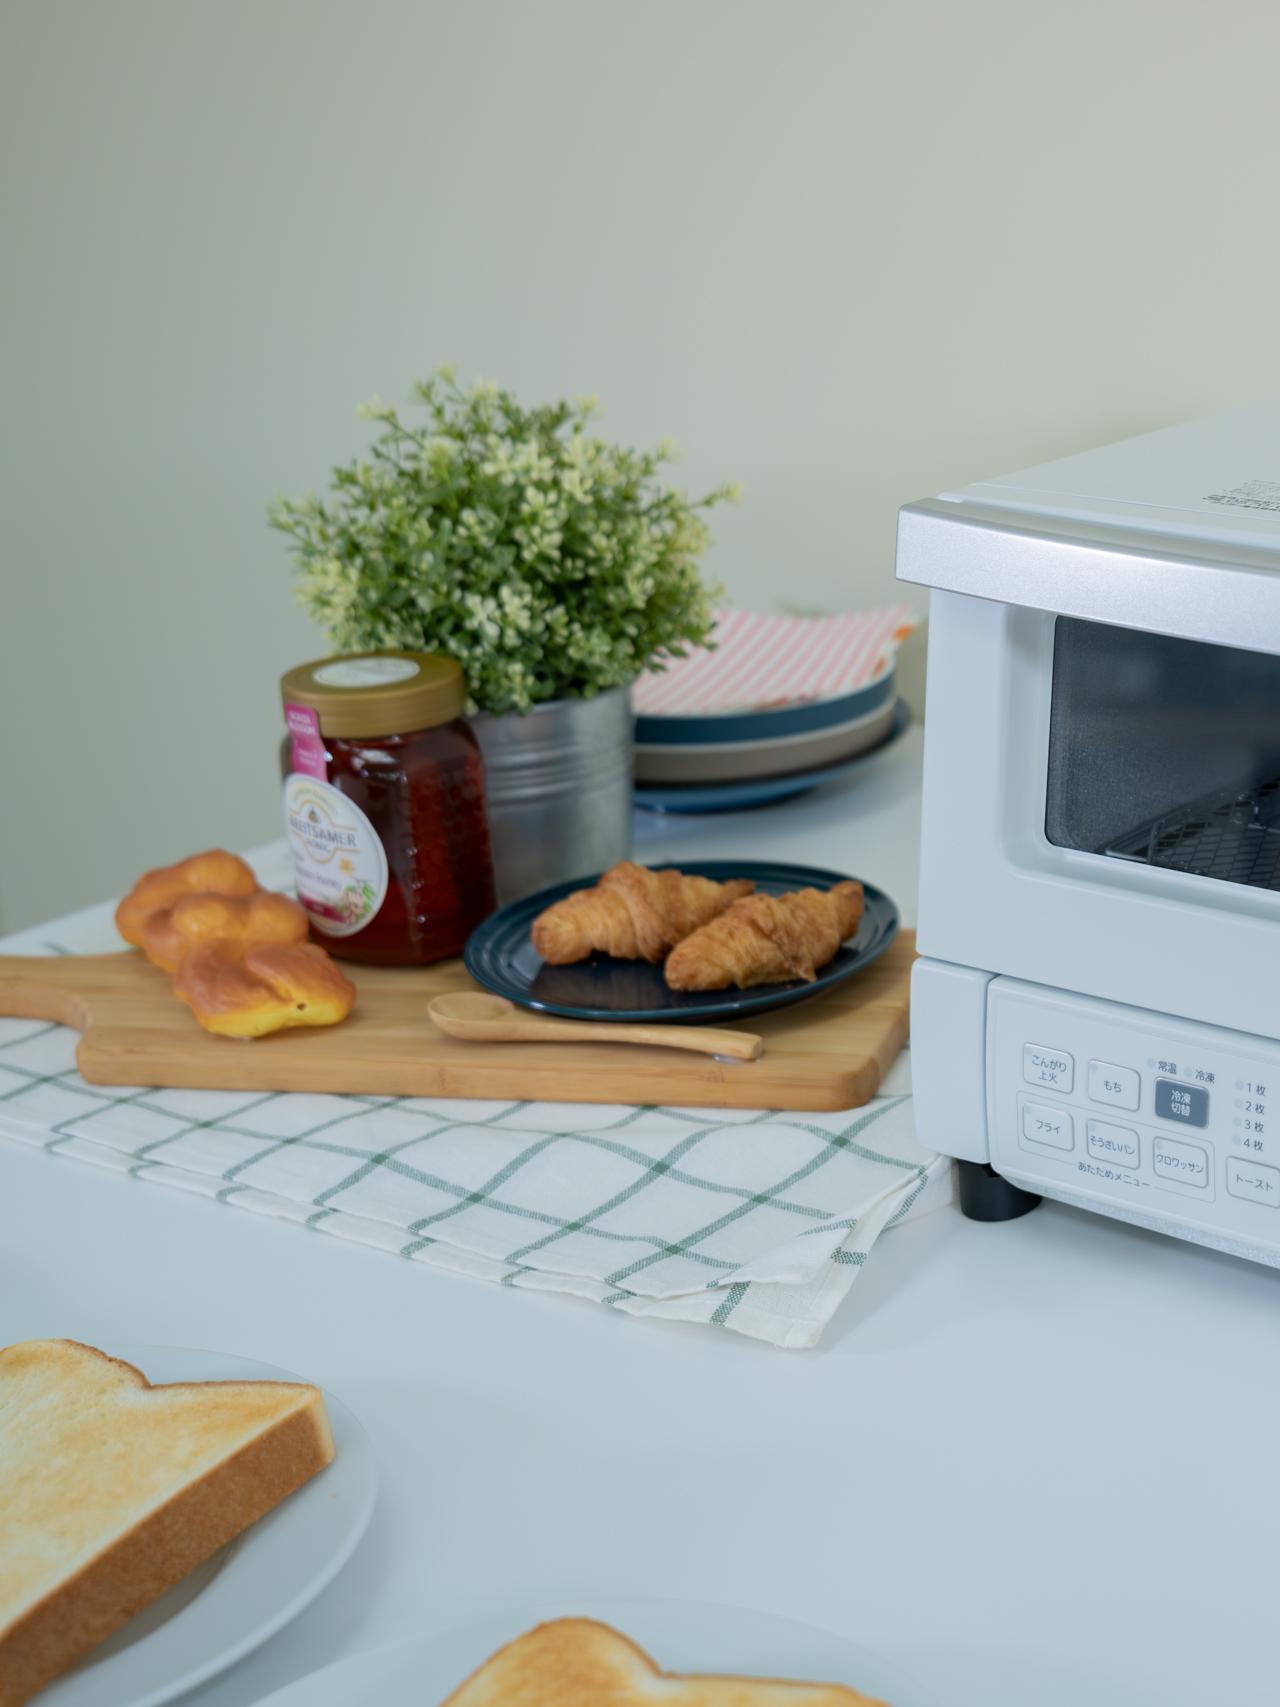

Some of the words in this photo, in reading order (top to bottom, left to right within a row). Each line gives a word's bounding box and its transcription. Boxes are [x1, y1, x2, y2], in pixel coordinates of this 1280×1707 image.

[1031, 1055, 1067, 1073] こんがり
[1158, 1060, 1177, 1075] 常温
[1039, 1071, 1058, 1085] 上火
[1195, 1069, 1215, 1084] 冷凍
[1103, 1079, 1122, 1094] もち
[1171, 1089, 1191, 1105] 冷凍
[1171, 1102, 1191, 1117] 切替
[1034, 1119, 1062, 1135] フライ
[1090, 1134, 1136, 1155] そうざいパン
[1155, 1153, 1204, 1173] クロワッサン
[1077, 1162, 1151, 1187] あたためメニュー
[1235, 1173, 1274, 1193] トースト
